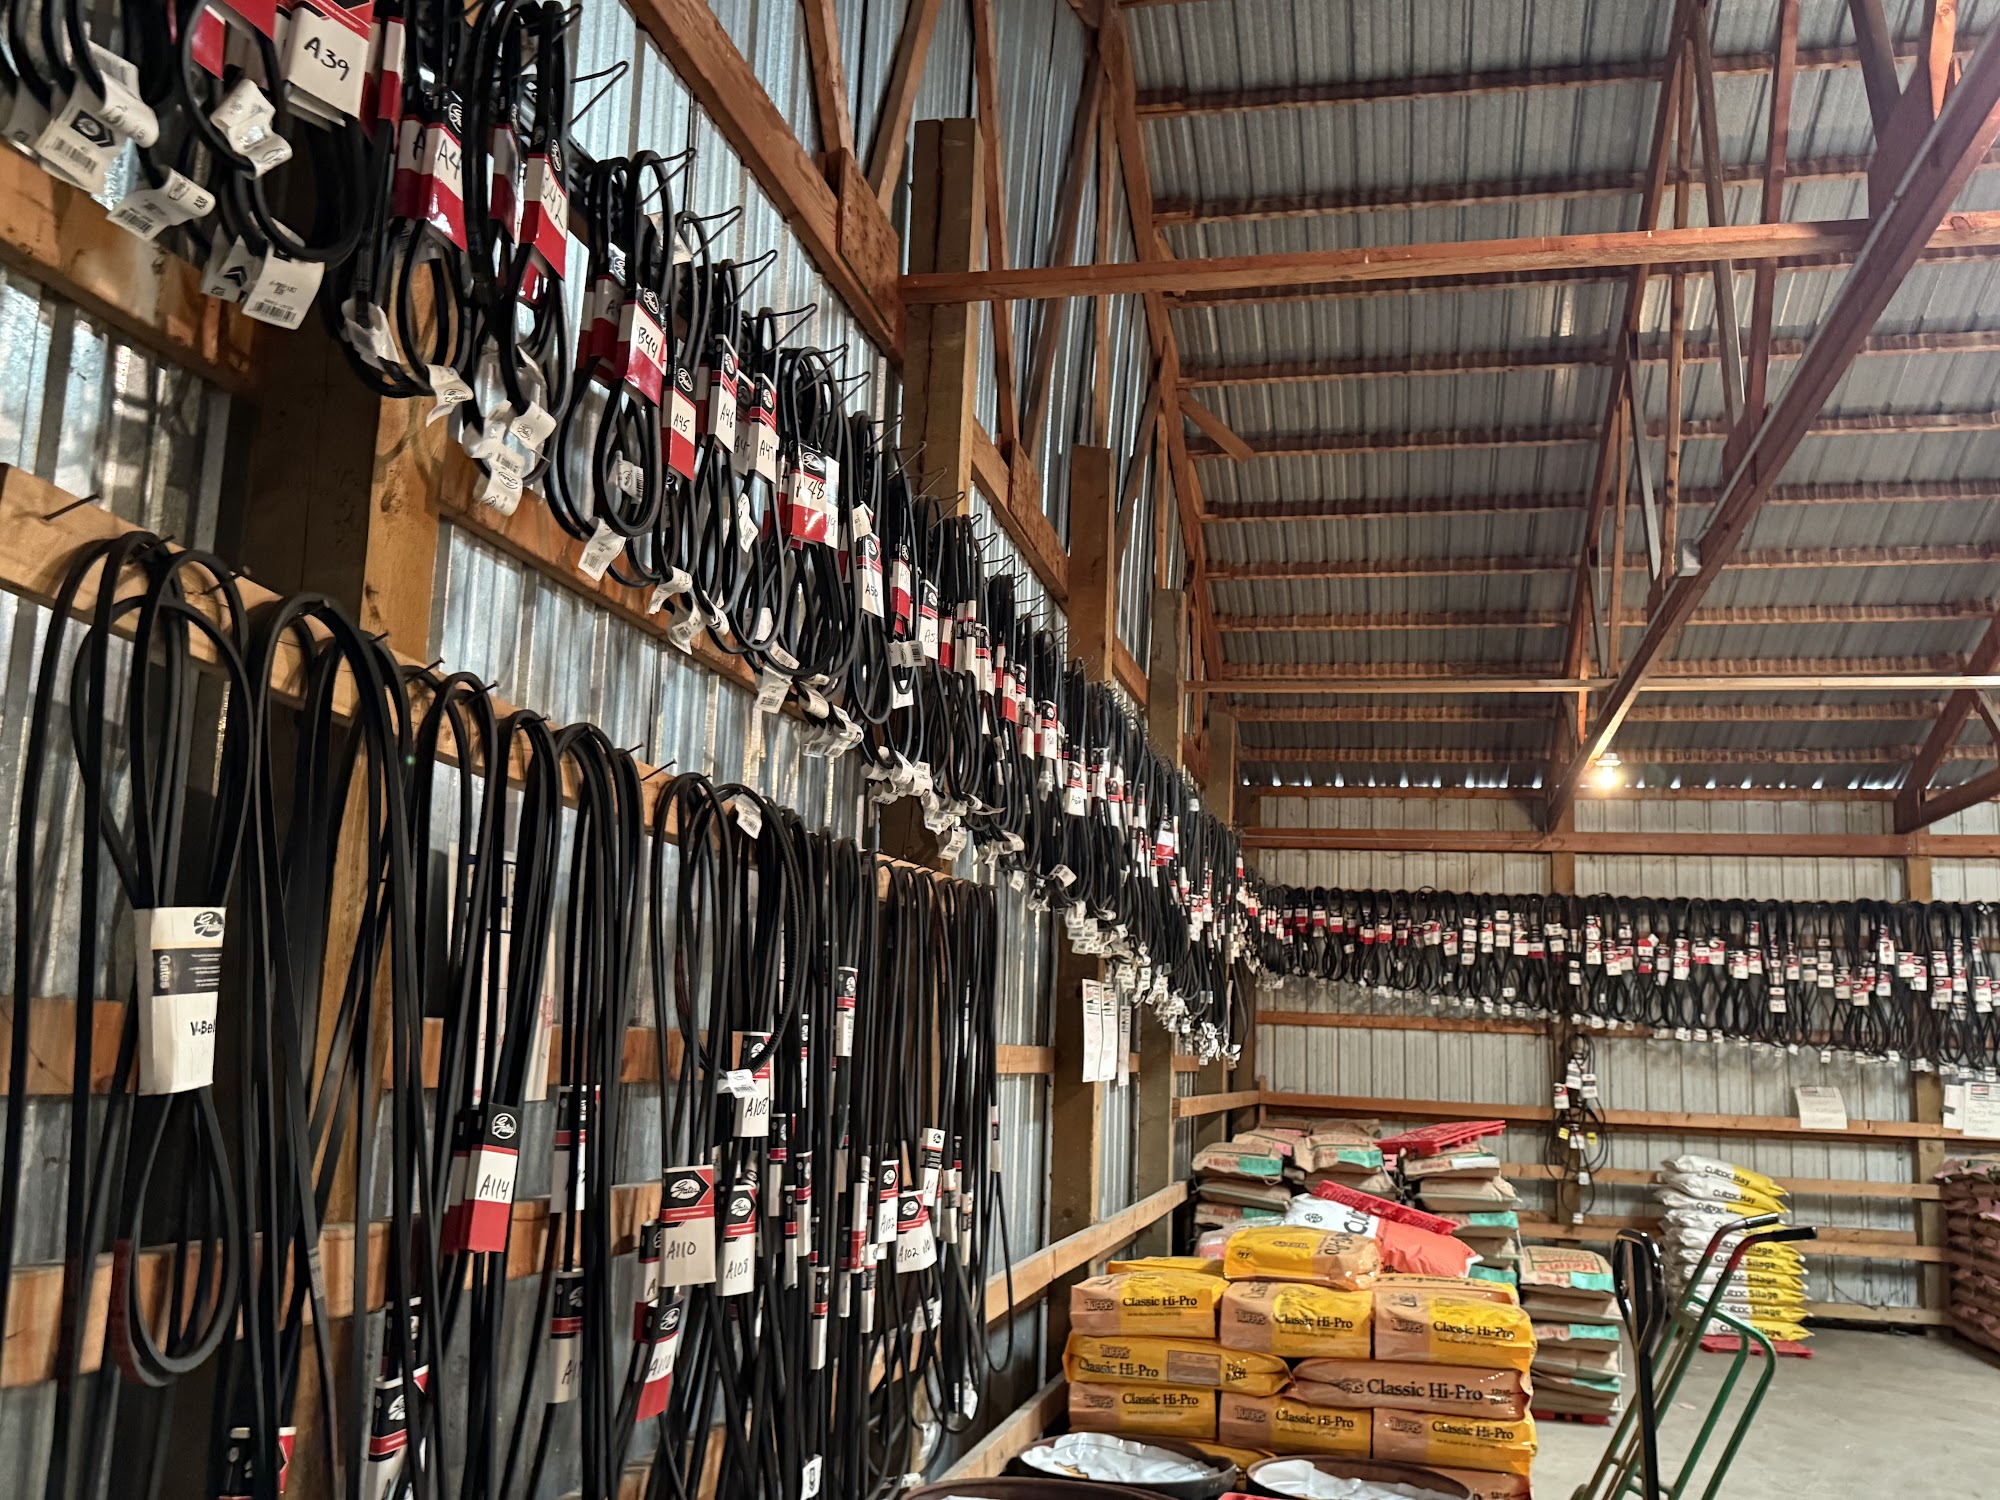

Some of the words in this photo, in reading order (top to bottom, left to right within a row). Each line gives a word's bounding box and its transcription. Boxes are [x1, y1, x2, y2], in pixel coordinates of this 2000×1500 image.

[304, 37, 350, 81] A39
[437, 139, 462, 180] A4
[637, 326, 658, 359] B44
[673, 413, 690, 433] A45
[720, 403, 733, 428] A46
[479, 1174, 509, 1200] A114
[670, 1179, 701, 1199] Gates
[1733, 1174, 1751, 1186] Hay
[1740, 1193, 1757, 1205] Hay
[666, 1240, 697, 1260] A110
[897, 1245, 919, 1263] A102
[1746, 1258, 1776, 1269] Silage
[1747, 1274, 1777, 1285] Silage
[1123, 1296, 1160, 1307] Classic
[1162, 1295, 1198, 1308] Hi-Pro
[1749, 1290, 1779, 1301] Silage
[1752, 1305, 1782, 1317] Silage
[1275, 1314, 1313, 1326] Classic
[1316, 1315, 1354, 1329] Hi-Pro
[1433, 1320, 1474, 1334] Classic
[1477, 1325, 1515, 1340] Hi-Pro
[1079, 1358, 1117, 1375] Classic
[1119, 1362, 1160, 1378] Hi-Pro
[1122, 1393, 1161, 1405] Classic
[1163, 1394, 1199, 1406] Hi-Pro
[1367, 1379, 1425, 1397] Classic
[1429, 1382, 1484, 1401] Hi-Pro
[1276, 1409, 1315, 1424] Classic
[1317, 1414, 1355, 1429] Hi-Pro
[1432, 1421, 1473, 1436] Classic
[1476, 1426, 1515, 1440] Hi-Pro
